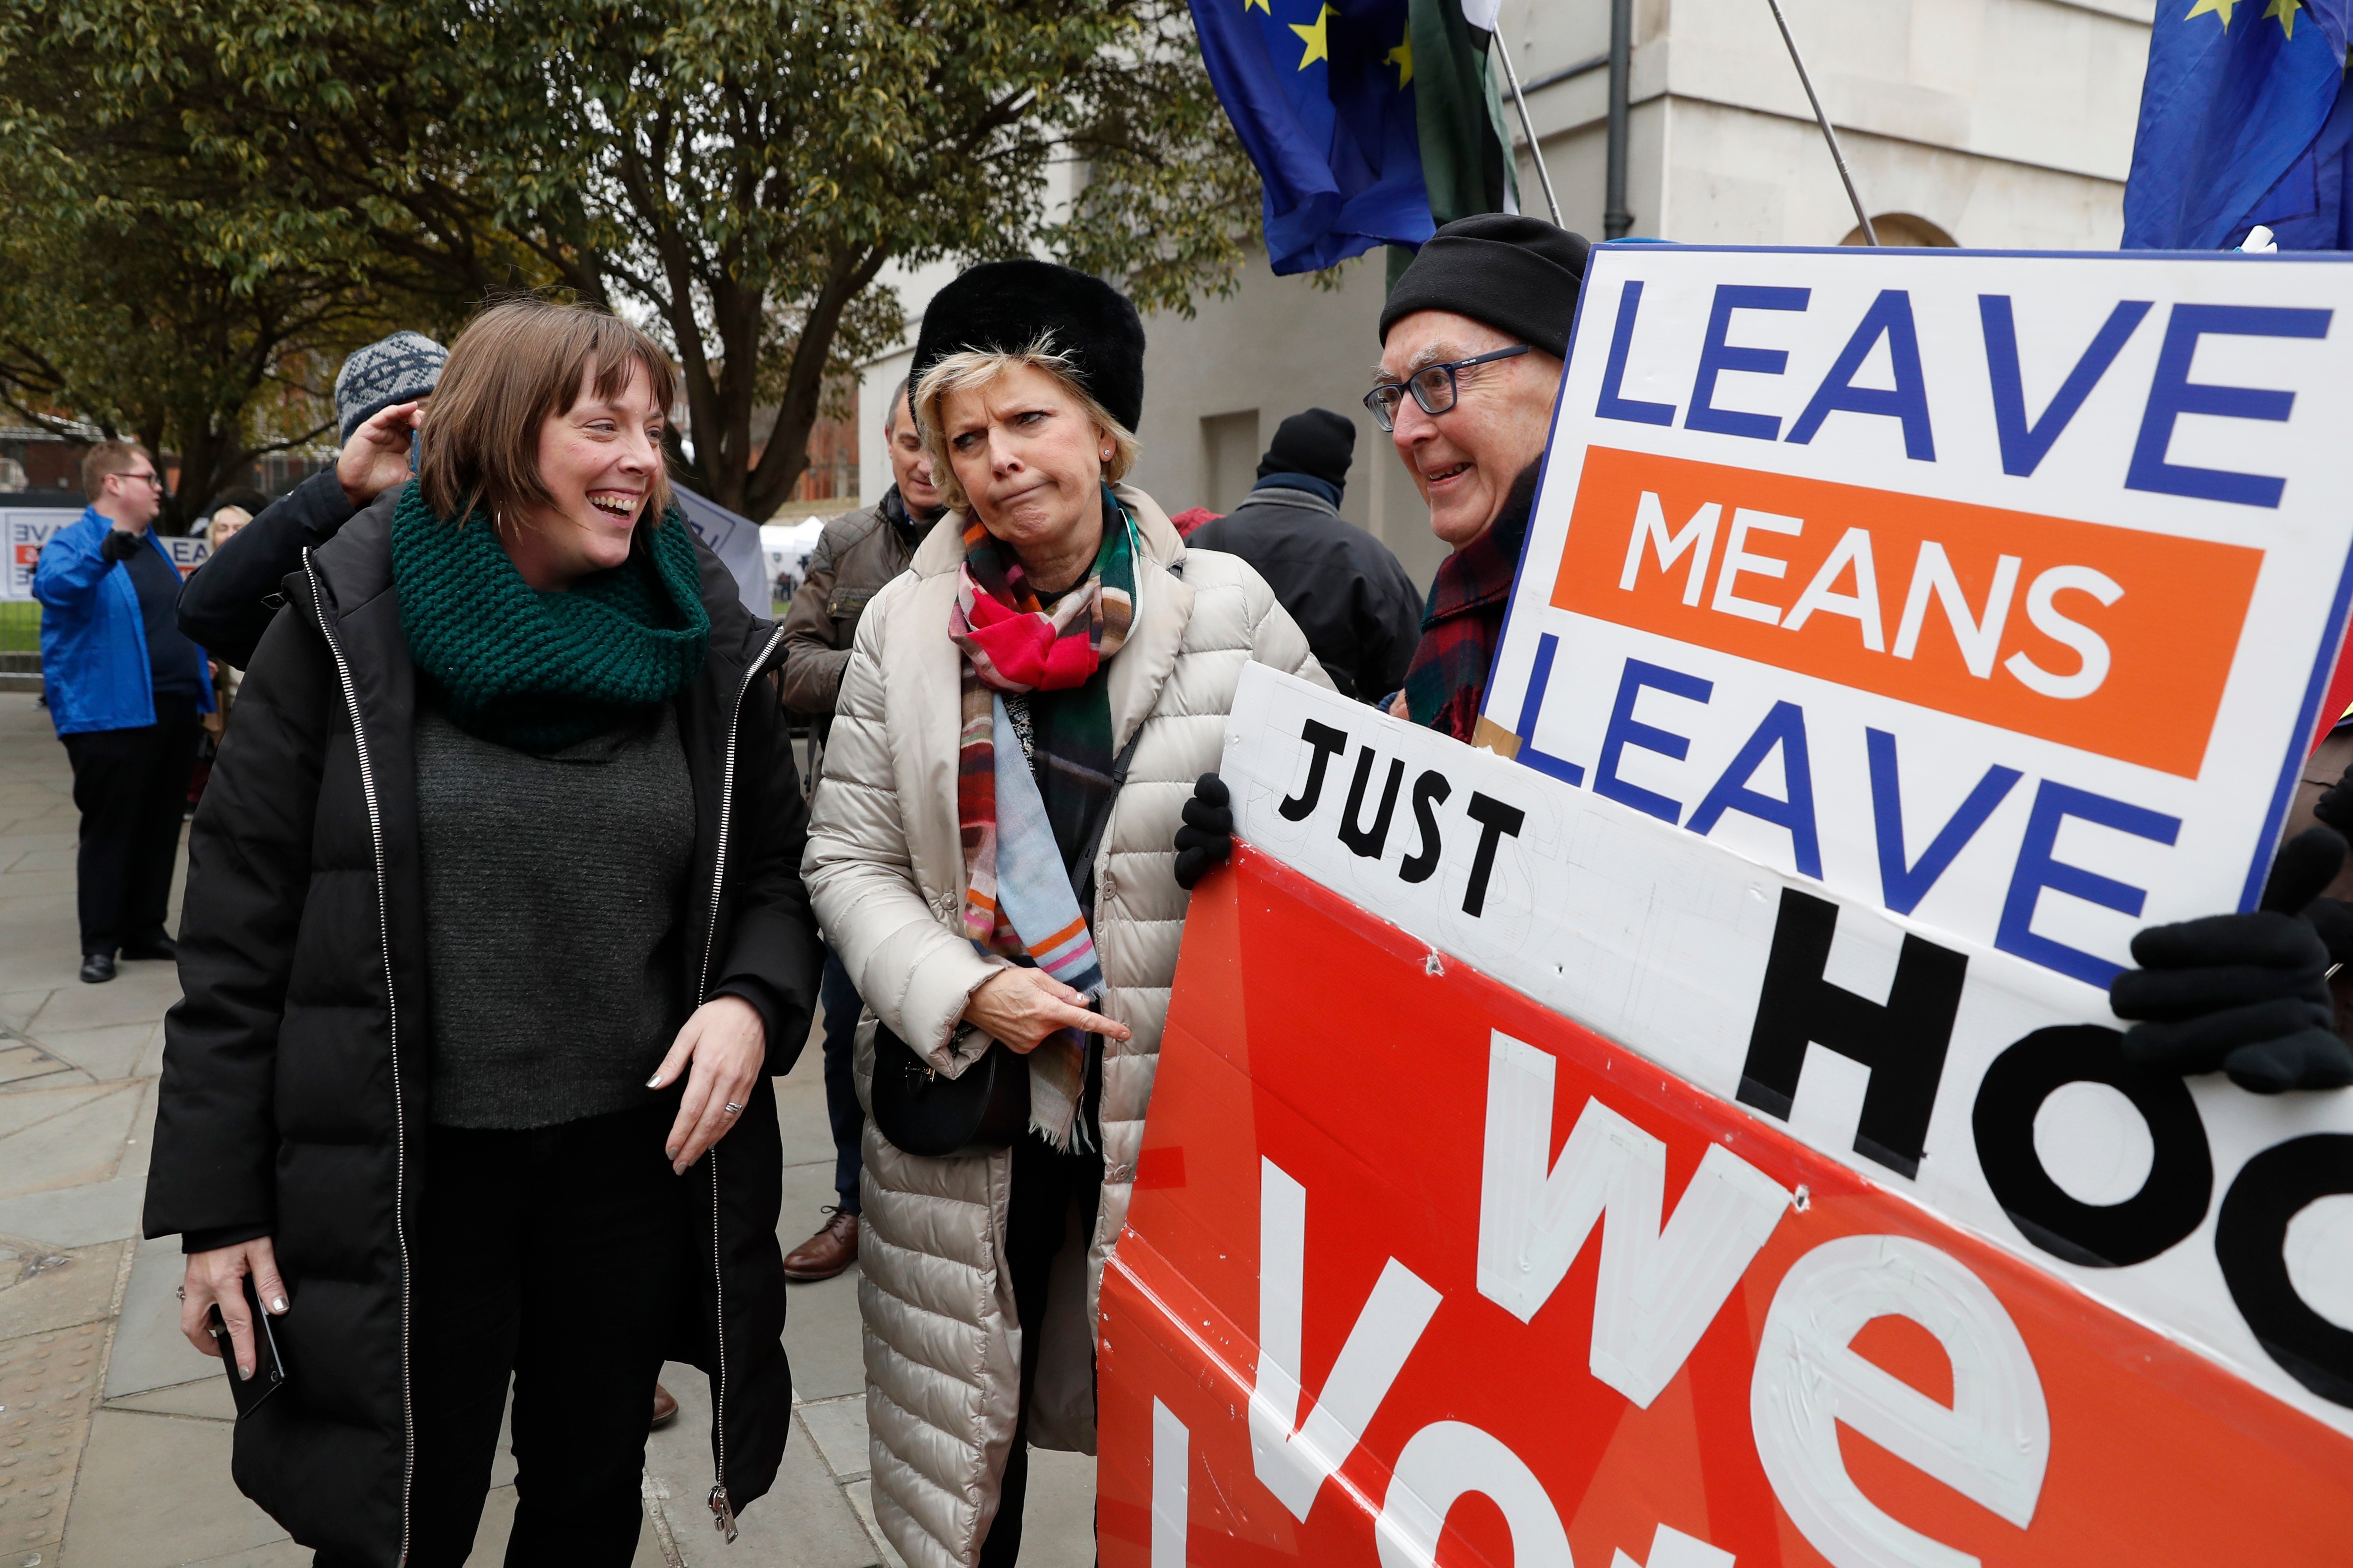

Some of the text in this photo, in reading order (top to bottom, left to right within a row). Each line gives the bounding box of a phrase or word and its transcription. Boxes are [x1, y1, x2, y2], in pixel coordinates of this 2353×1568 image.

[1594, 280, 2335, 510] LEAVE
[1618, 490, 2125, 700] MEANS
[1278, 718, 1526, 918] JUST
[1514, 633, 2183, 992] LEAVE
